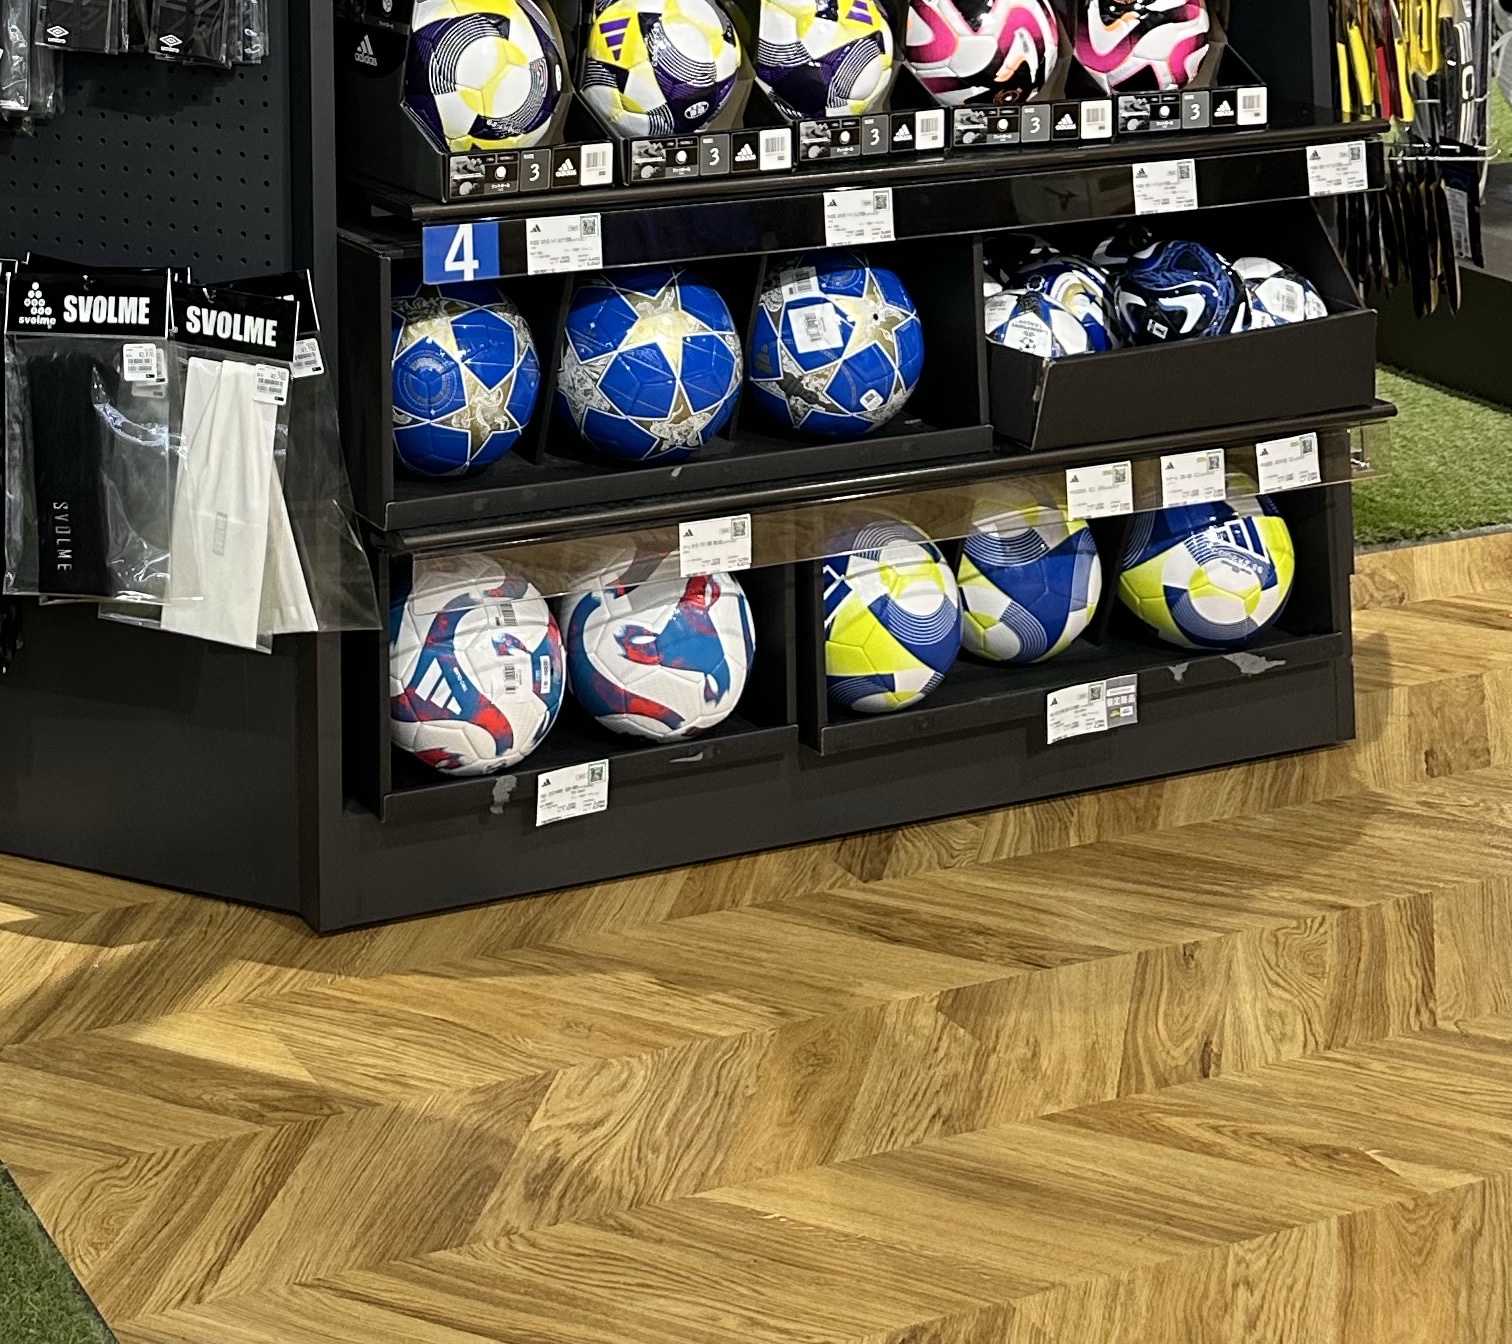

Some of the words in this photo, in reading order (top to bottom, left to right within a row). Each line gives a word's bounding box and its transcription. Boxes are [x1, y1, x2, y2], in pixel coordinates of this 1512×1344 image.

[1191, 104, 1200, 120] 3
[1030, 117, 1040, 134] 3
[870, 128, 880, 146] 3
[710, 148, 719, 166] 3
[529, 164, 540, 182] 3
[444, 223, 479, 281] 4
[63, 294, 150, 325] SVOLME
[186, 305, 278, 347] SVOLME
[53, 501, 73, 571] SVOLME
